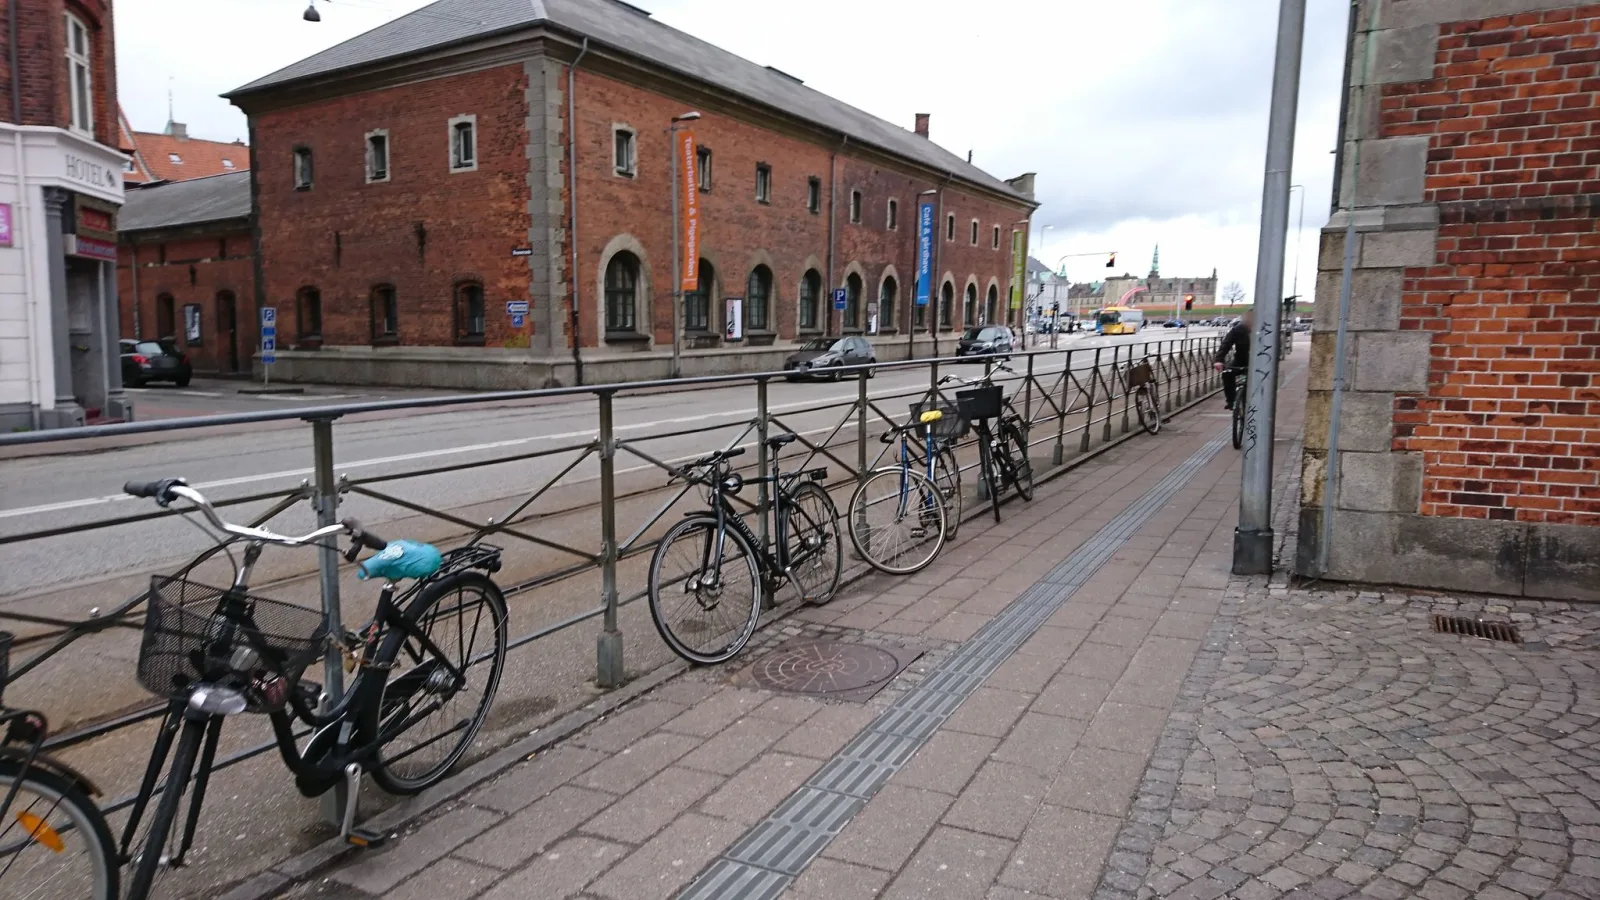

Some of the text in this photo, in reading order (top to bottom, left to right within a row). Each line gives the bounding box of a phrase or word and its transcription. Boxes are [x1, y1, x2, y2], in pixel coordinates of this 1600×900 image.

[65, 154, 104, 186] HOTEL
[689, 207, 696, 216] &
[923, 206, 931, 225] Café
[923, 227, 931, 235] &
